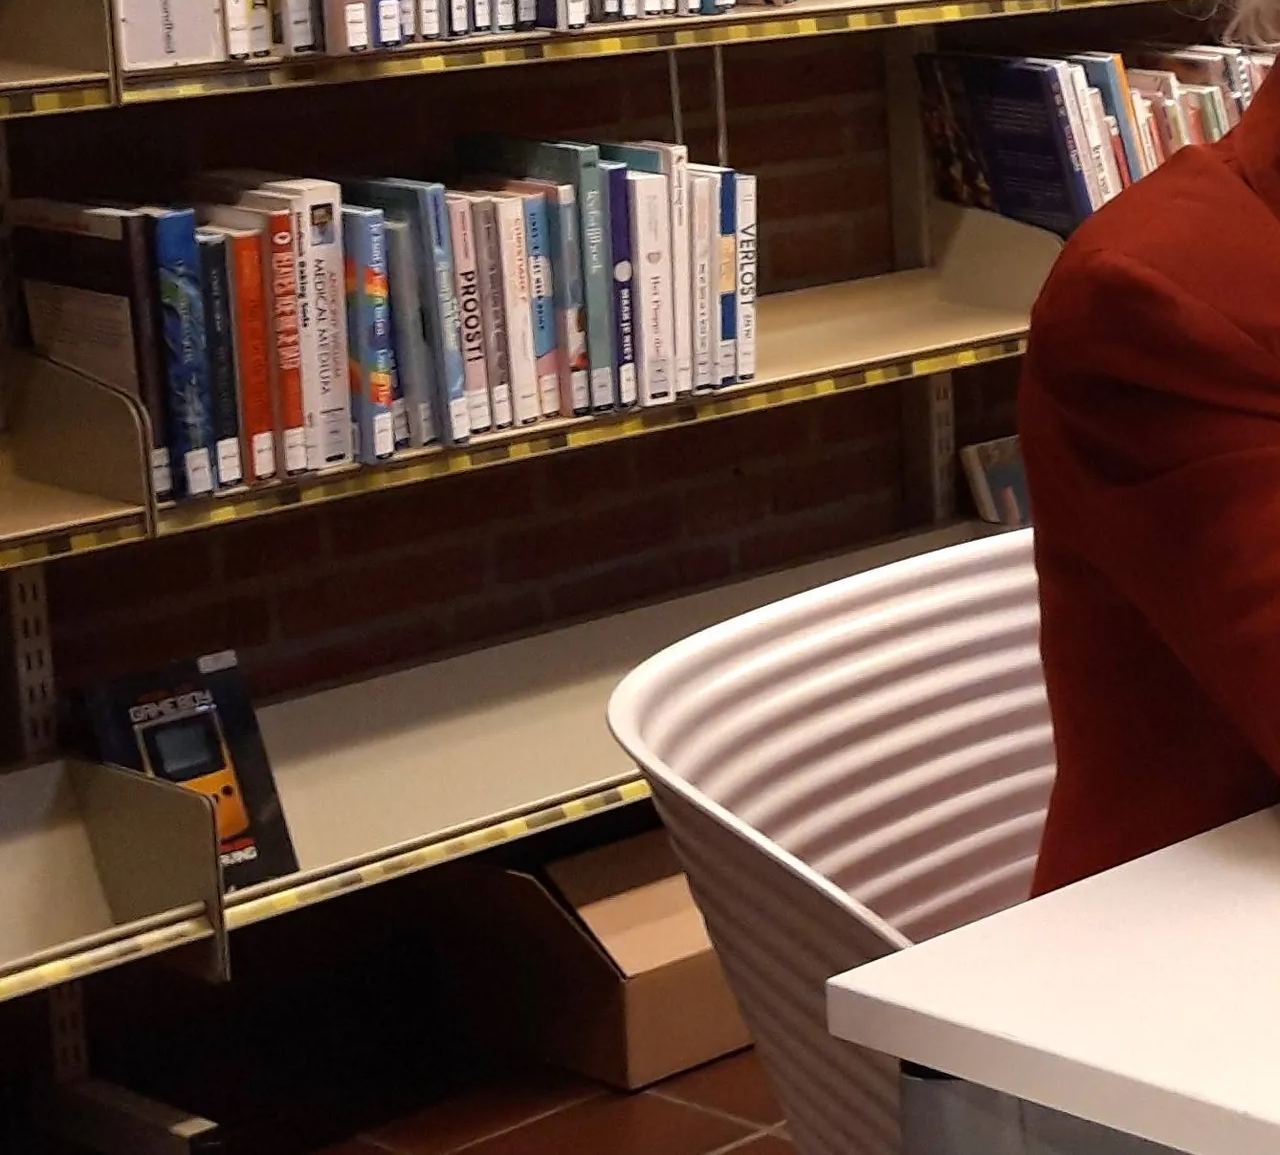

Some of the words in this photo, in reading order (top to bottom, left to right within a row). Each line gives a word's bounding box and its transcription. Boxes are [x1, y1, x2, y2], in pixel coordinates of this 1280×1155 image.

[313, 258, 328, 324] MEDICAL
[739, 223, 756, 306] VERLOST
[459, 270, 484, 363] PROOST!
[316, 327, 331, 396] MEDIUM
